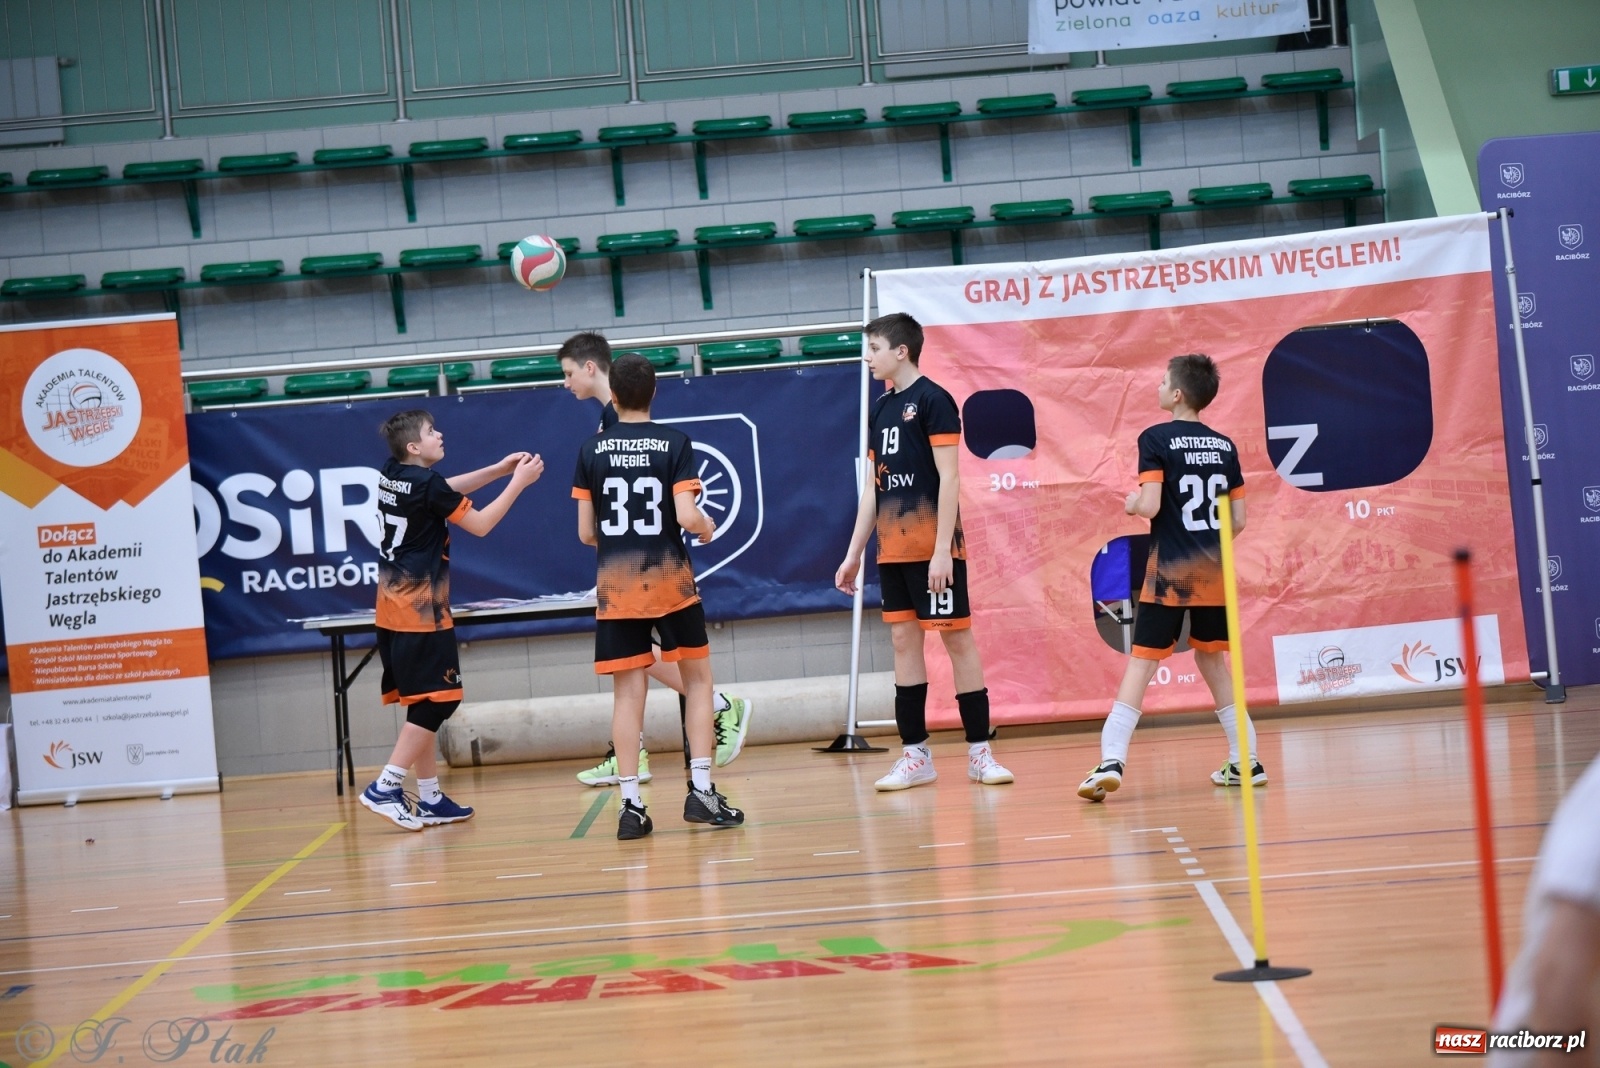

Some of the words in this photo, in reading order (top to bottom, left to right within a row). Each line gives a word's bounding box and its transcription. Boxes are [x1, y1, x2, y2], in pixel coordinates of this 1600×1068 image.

[1056, 15, 1131, 31] zielona
[1148, 10, 1200, 25] oaza
[1217, 3, 1279, 19] kultur
[1497, 190, 1531, 199] RACIBÓRZ
[1556, 252, 1590, 261] RACIBÓRZ
[964, 277, 1029, 306] GRAJ
[1038, 275, 1055, 299] Z
[1062, 254, 1263, 303] JASTRZĘBSKIM
[1270, 236, 1402, 278] WĘGLEM!
[36, 369, 76, 408] AKADEMIA
[594, 438, 669, 454] JASTRZĘBSKI
[881, 426, 899, 455] 19
[1169, 436, 1231, 452] JASTRZĘBSKI
[609, 454, 651, 469] WĘGIEL
[1184, 451, 1223, 466] WĘGIEL
[887, 473, 914, 490] JSW
[989, 472, 1017, 492] 30
[1022, 480, 1041, 489] PKT
[601, 476, 662, 536] 33
[1179, 473, 1228, 531] 28
[1345, 499, 1371, 519] 10
[1377, 506, 1396, 517] PKT
[40, 526, 94, 544] Dołącz
[43, 548, 62, 564] do
[67, 543, 143, 562] Akademii
[46, 567, 118, 585] Talentów
[242, 556, 379, 594] RACIBÓR
[46, 586, 161, 609] Jastrzębskiego
[927, 588, 953, 615] 19
[49, 611, 97, 630] Węgla
[29, 646, 62, 654] Akademia
[63, 644, 93, 652] Talentów
[94, 641, 142, 651] Jastrzębskiego
[143, 638, 162, 647] Węgla
[34, 655, 57, 665] Zespół
[57, 654, 75, 662] Szkół
[76, 652, 116, 661] Mistrzostwa
[117, 649, 157, 659] Sportowego
[35, 665, 77, 675] Niepubliczna
[97, 662, 122, 671] Szkolna
[36, 675, 83, 685] Minisiatkówka
[95, 672, 114, 680] dzieci
[142, 667, 180, 679] publicznych
[1177, 673, 1196, 684] PKT
[71, 750, 103, 769] JSW
